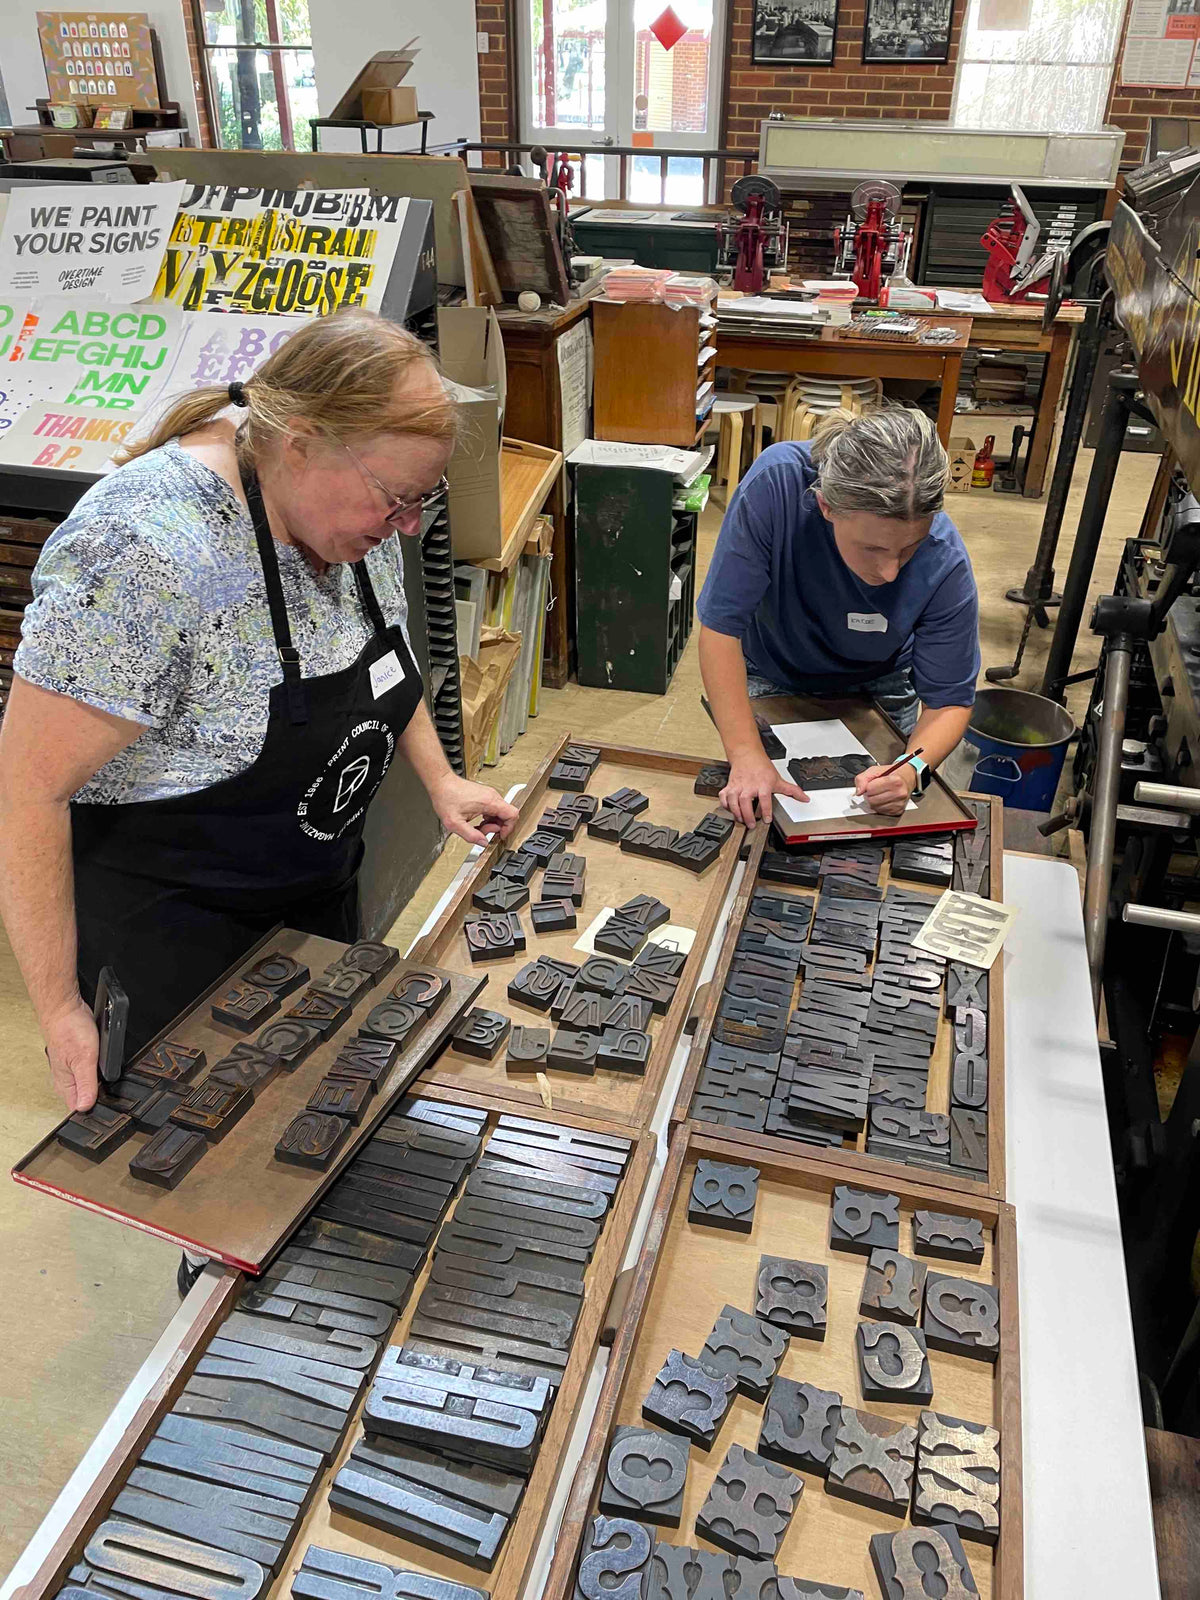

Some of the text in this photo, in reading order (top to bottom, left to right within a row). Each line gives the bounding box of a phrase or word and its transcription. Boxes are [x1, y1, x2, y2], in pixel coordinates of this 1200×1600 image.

[31, 204, 158, 228] WE PAINT
[14, 228, 161, 256] YOUR SIGNS
[58, 266, 105, 283] OVERTIME
[62, 277, 96, 290] DESIGN
[50, 310, 167, 340] ABCD
[28, 338, 168, 370] EFGHIJ
[32, 413, 135, 443] THANKS
[327, 737, 350, 767] PRINT
[351, 720, 380, 738] COUNCIL
[380, 723, 390, 733] OF
[297, 801, 309, 816] EST
